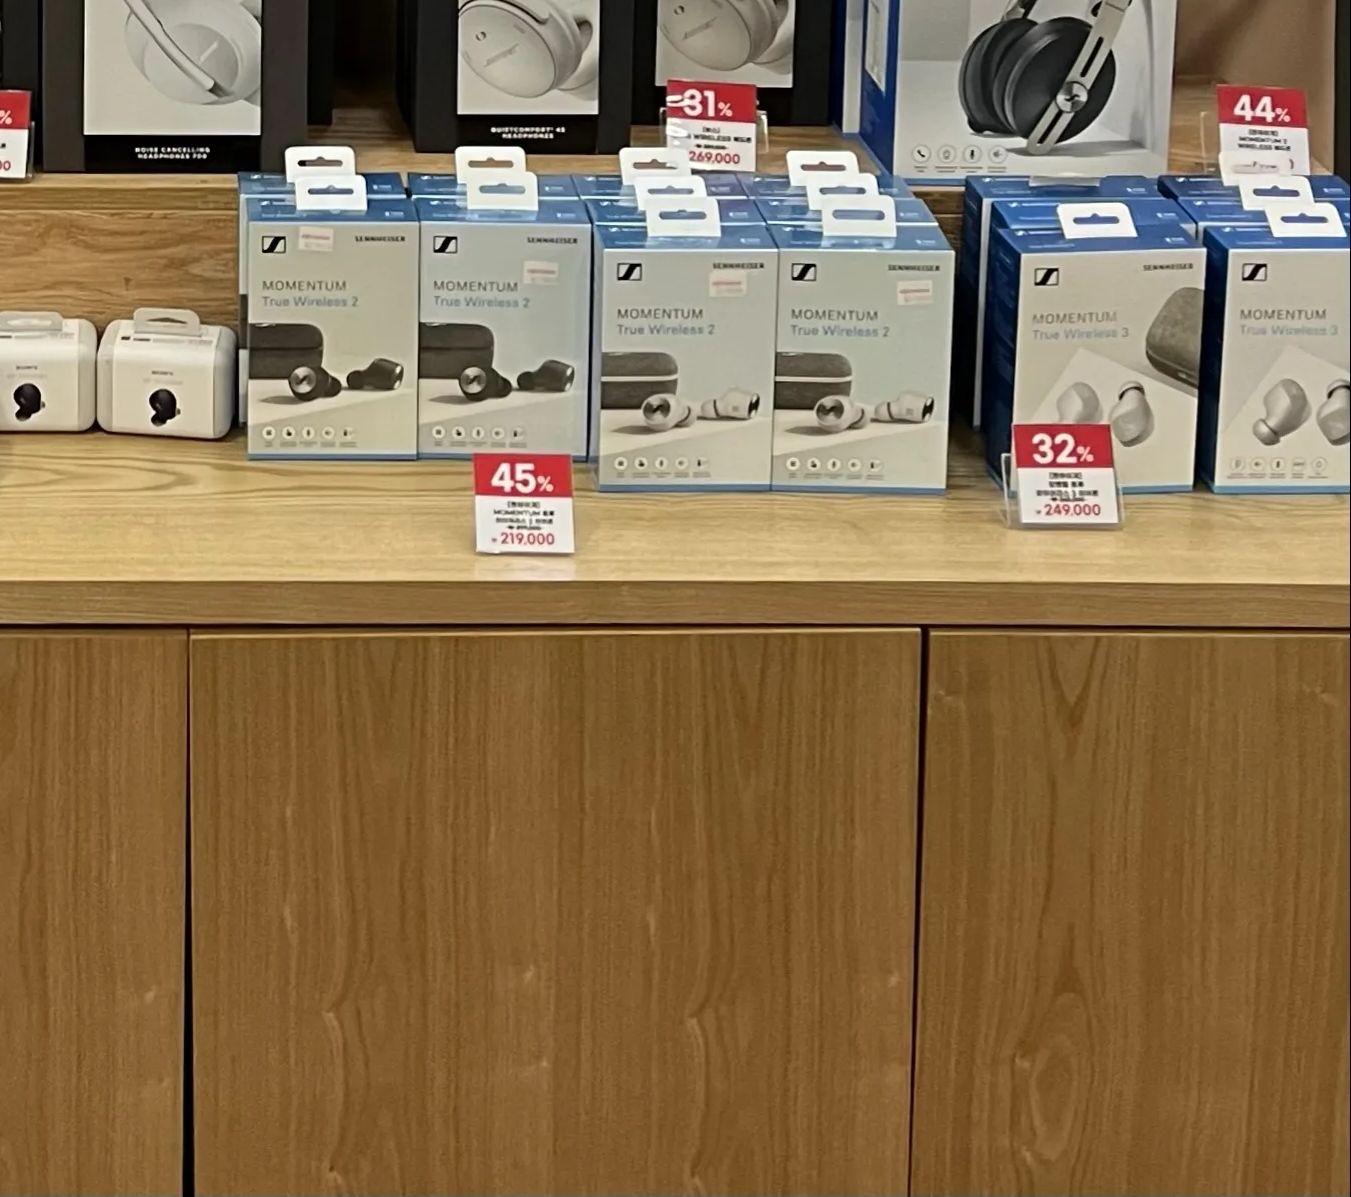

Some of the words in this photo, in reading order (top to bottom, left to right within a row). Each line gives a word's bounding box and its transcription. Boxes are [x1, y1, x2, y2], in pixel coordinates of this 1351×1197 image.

[683, 88, 733, 117] 31%
[1233, 94, 1291, 122] 44%
[1143, 263, 1194, 271] SENNHEISER
[262, 280, 347, 291] MOMENTUM
[434, 280, 519, 292] MOMENTUM
[262, 297, 290, 307] True
[294, 296, 347, 307] Wireless
[351, 297, 359, 307] 2
[434, 296, 460, 307] True
[464, 297, 519, 308] Wireless
[522, 298, 530, 308] 2
[617, 308, 704, 319] MOMENTUM
[791, 309, 879, 321] MOMENTUM
[1032, 311, 1117, 325] MOMENTUM
[1240, 309, 1326, 321] MOMENTUM
[617, 324, 645, 335] True
[649, 324, 704, 335] Wireless
[707, 325, 715, 335] 2
[791, 325, 819, 336] True
[822, 325, 878, 337] Wireless
[882, 326, 890, 337] 2
[1032, 329, 1060, 340] True
[1064, 328, 1117, 339] Wireless
[1121, 327, 1129, 338] 3
[1240, 324, 1267, 336] True
[1271, 324, 1326, 336] Wireless
[1330, 324, 1339, 335] 3
[1032, 432, 1094, 464] 32%
[491, 462, 554, 494] 45%
